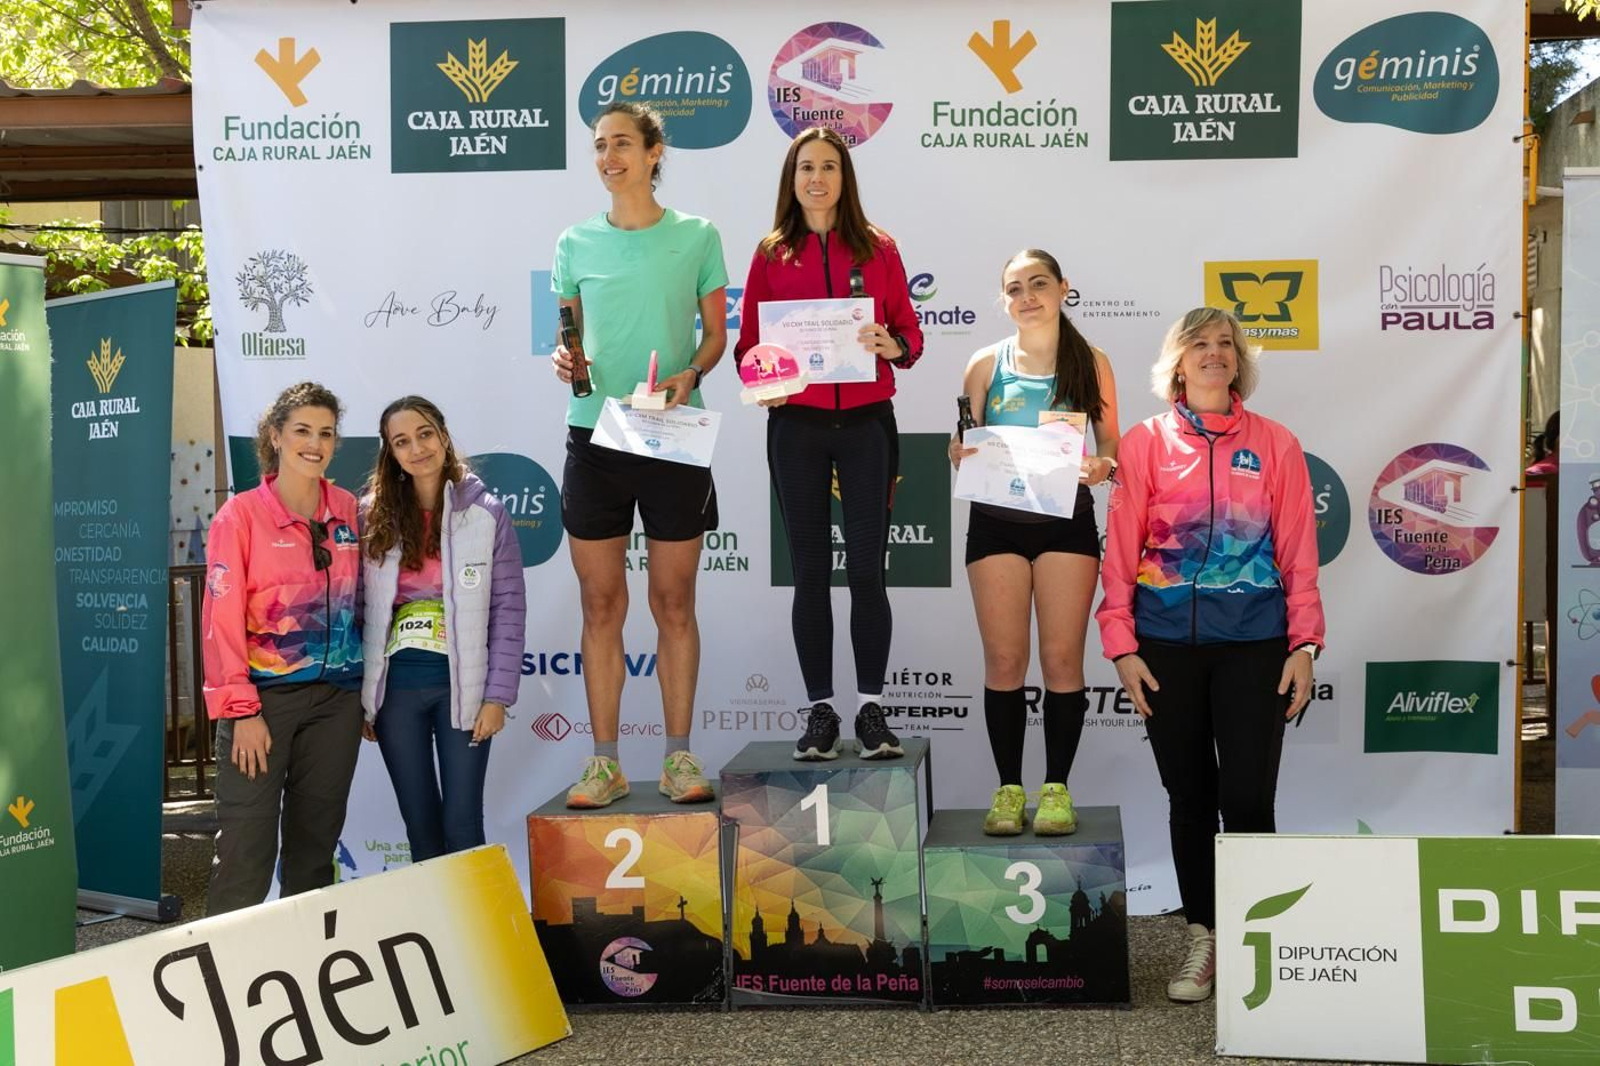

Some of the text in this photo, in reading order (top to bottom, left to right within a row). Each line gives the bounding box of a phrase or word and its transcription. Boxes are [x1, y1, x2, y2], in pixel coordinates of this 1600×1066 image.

[1423, 80, 1467, 91] Marketing
[776, 87, 801, 103] IES
[1391, 91, 1439, 102] Publicidad
[793, 107, 844, 121] Fuente
[933, 99, 1078, 127] Fundación
[1128, 93, 1281, 143] CAJA RURAL JAÉN
[224, 113, 361, 141] Fundación
[407, 108, 549, 157] CAJA RURAL JAÉN
[921, 129, 1089, 148] CAJA RURAL JAÉN
[212, 141, 371, 162] CAJA RURAL JAÉN
[1380, 263, 1495, 311] Psicología
[427, 290, 500, 330] Baby
[0, 329, 26, 341] ación
[1241, 326, 1299, 339] asymas
[242, 332, 305, 357] Oliaesa
[71, 397, 140, 419] CAJA RURAL
[89, 419, 119, 440] JAÉN
[54, 500, 118, 517] MPROMISO
[1377, 508, 1403, 525] IES
[79, 519, 141, 539] CERCANÍA
[888, 525, 934, 544] RAL
[1394, 529, 1448, 544] Fuente
[55, 546, 122, 562] ONESTIDAD
[1424, 544, 1447, 553] de la
[704, 552, 749, 571] JAÉN
[1424, 555, 1461, 569] Peña
[69, 568, 168, 585] TRANSPARENCIA
[76, 592, 148, 609] SOLVENCIA
[95, 613, 148, 630] SOLIDEZ
[399, 619, 433, 632] 1024
[82, 636, 139, 653] CALIDAD
[884, 668, 953, 686] IÉTOR
[1386, 691, 1479, 714] Aliviflex
[1100, 719, 1126, 727] YOUR
[801, 783, 830, 846] 1
[365, 840, 391, 851] Una
[604, 828, 645, 889] 2
[1004, 861, 1047, 924] 3
[1278, 945, 1398, 962] DIPUTACIÓN
[603, 966, 615, 974] IES
[1279, 965, 1357, 982] DE JAÉN
[153, 910, 456, 1066] Jaén
[736, 973, 919, 992] IES Fuente de la Peña
[983, 975, 1084, 990] #somoselcambio
